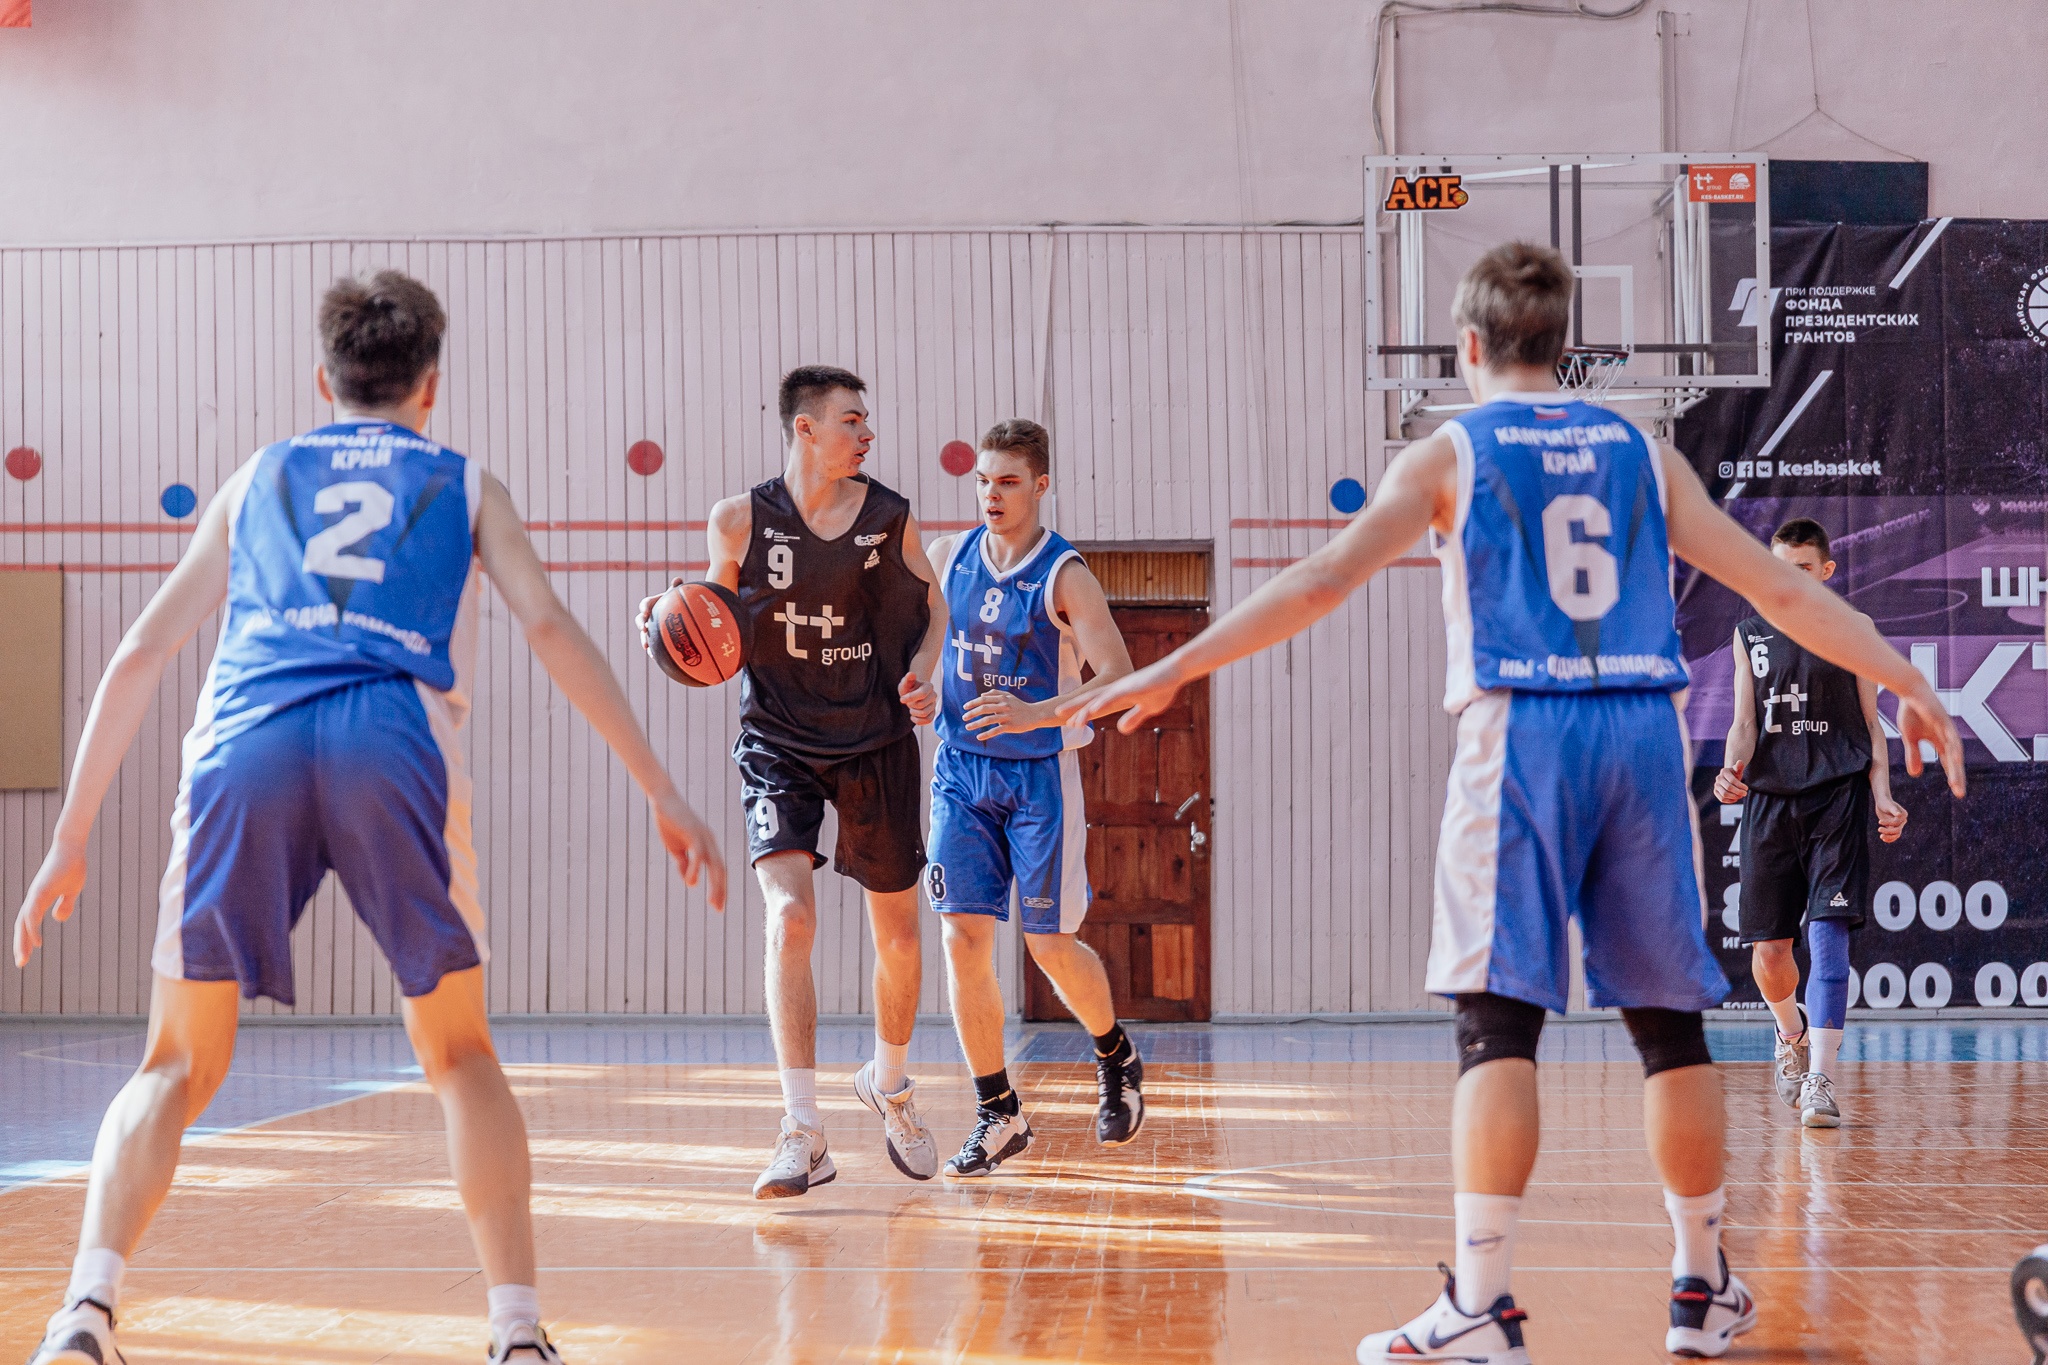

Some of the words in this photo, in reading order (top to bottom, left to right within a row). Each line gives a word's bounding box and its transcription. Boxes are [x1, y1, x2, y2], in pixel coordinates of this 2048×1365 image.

[1785, 287, 1807, 296] ПРИ
[1809, 286, 1877, 296] ПОДДЕРЖКЕ
[1785, 298, 1843, 311] ФОНДА
[1785, 313, 1920, 328] ПРЕЗИДЕНТСКИХ
[1784, 331, 1856, 344] ГРАНТОВ
[1542, 447, 1597, 475] КРАЙ
[1778, 460, 1882, 477] kesbasket
[302, 481, 394, 584] 2
[768, 545, 793, 590] 9
[1542, 494, 1621, 621] 6
[979, 587, 1004, 624] 8
[821, 642, 872, 666] group
[1750, 643, 1770, 679] 6
[983, 673, 1028, 690] group
[1791, 720, 1829, 735] group
[755, 797, 780, 841] 9
[929, 863, 947, 901] 8
[1873, 880, 2009, 931] 000
